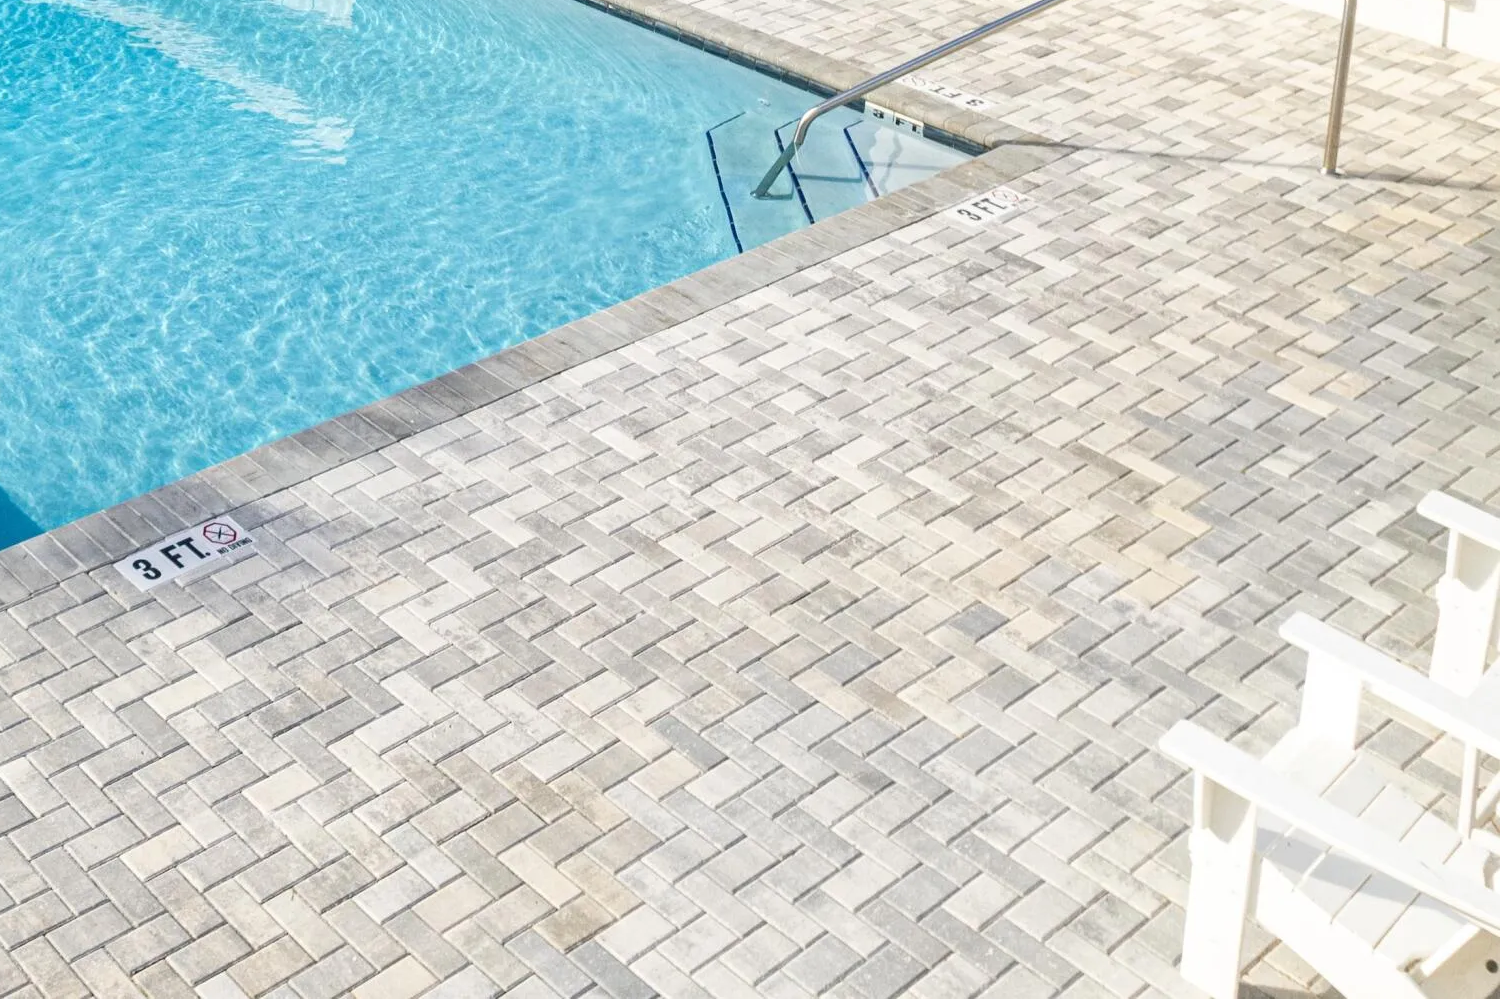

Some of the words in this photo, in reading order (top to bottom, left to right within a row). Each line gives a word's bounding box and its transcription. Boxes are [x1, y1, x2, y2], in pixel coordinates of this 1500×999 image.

[957, 209, 982, 221] 3
[216, 546, 229, 555] NO
[227, 536, 253, 551] DIVING
[132, 559, 162, 580] 3
[159, 537, 211, 569] FT.
